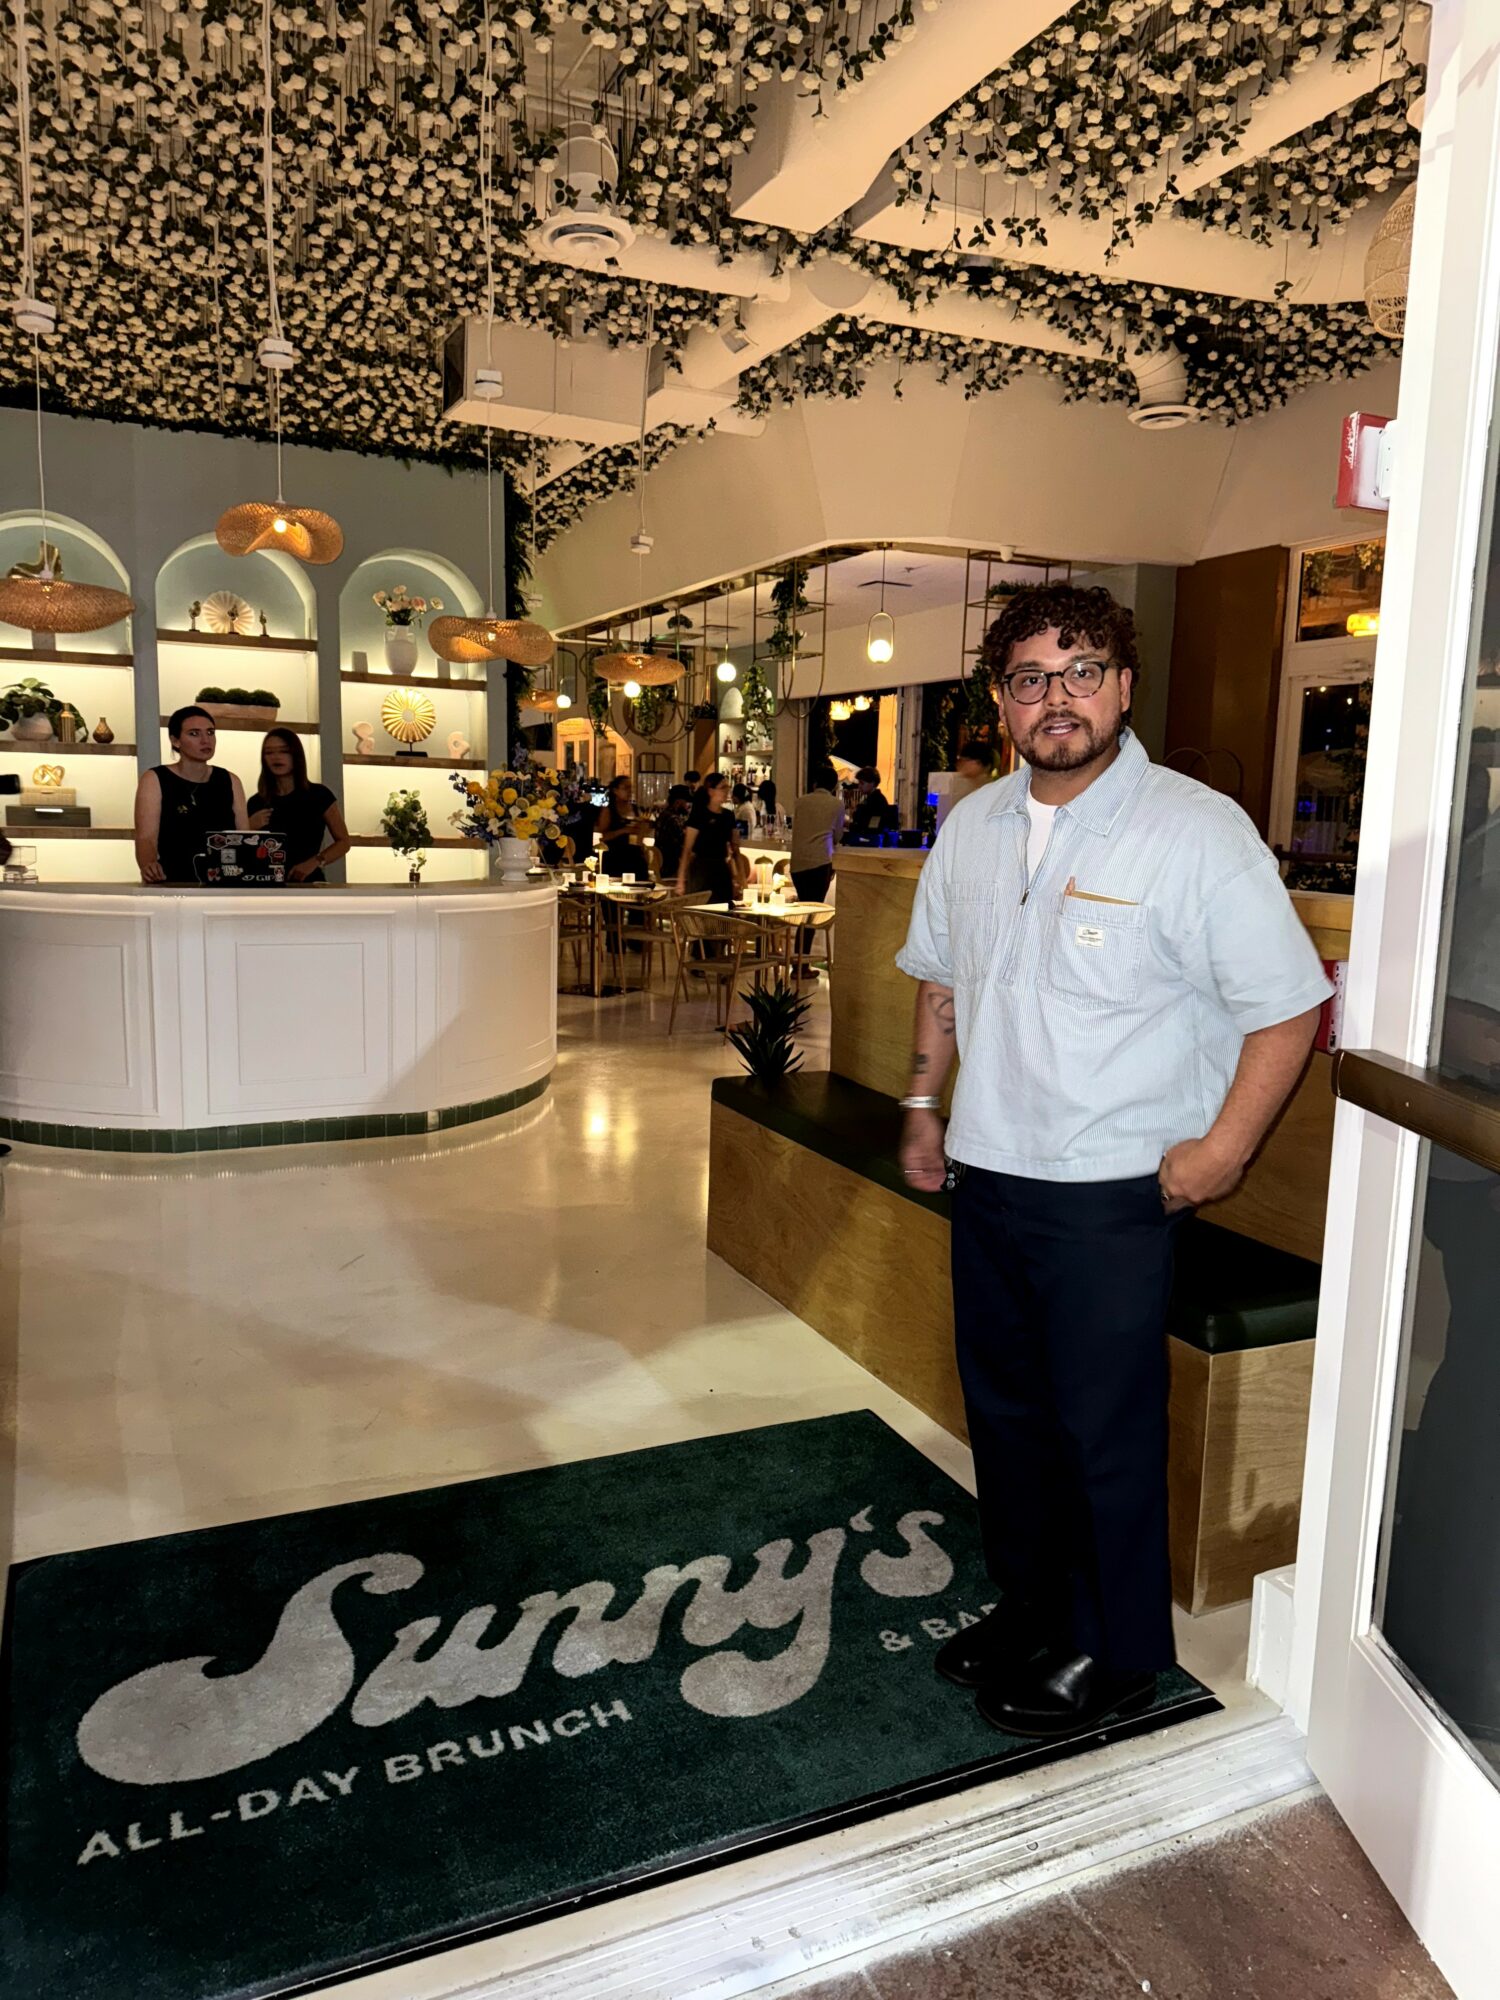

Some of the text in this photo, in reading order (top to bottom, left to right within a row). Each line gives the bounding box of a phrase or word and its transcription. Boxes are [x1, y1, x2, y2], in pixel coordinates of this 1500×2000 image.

[76, 1505, 955, 1786] Sunny's
[77, 1765, 360, 1866] ALL-DAY
[383, 1698, 634, 1785] BRUNCH
[878, 1629, 915, 1652] &
